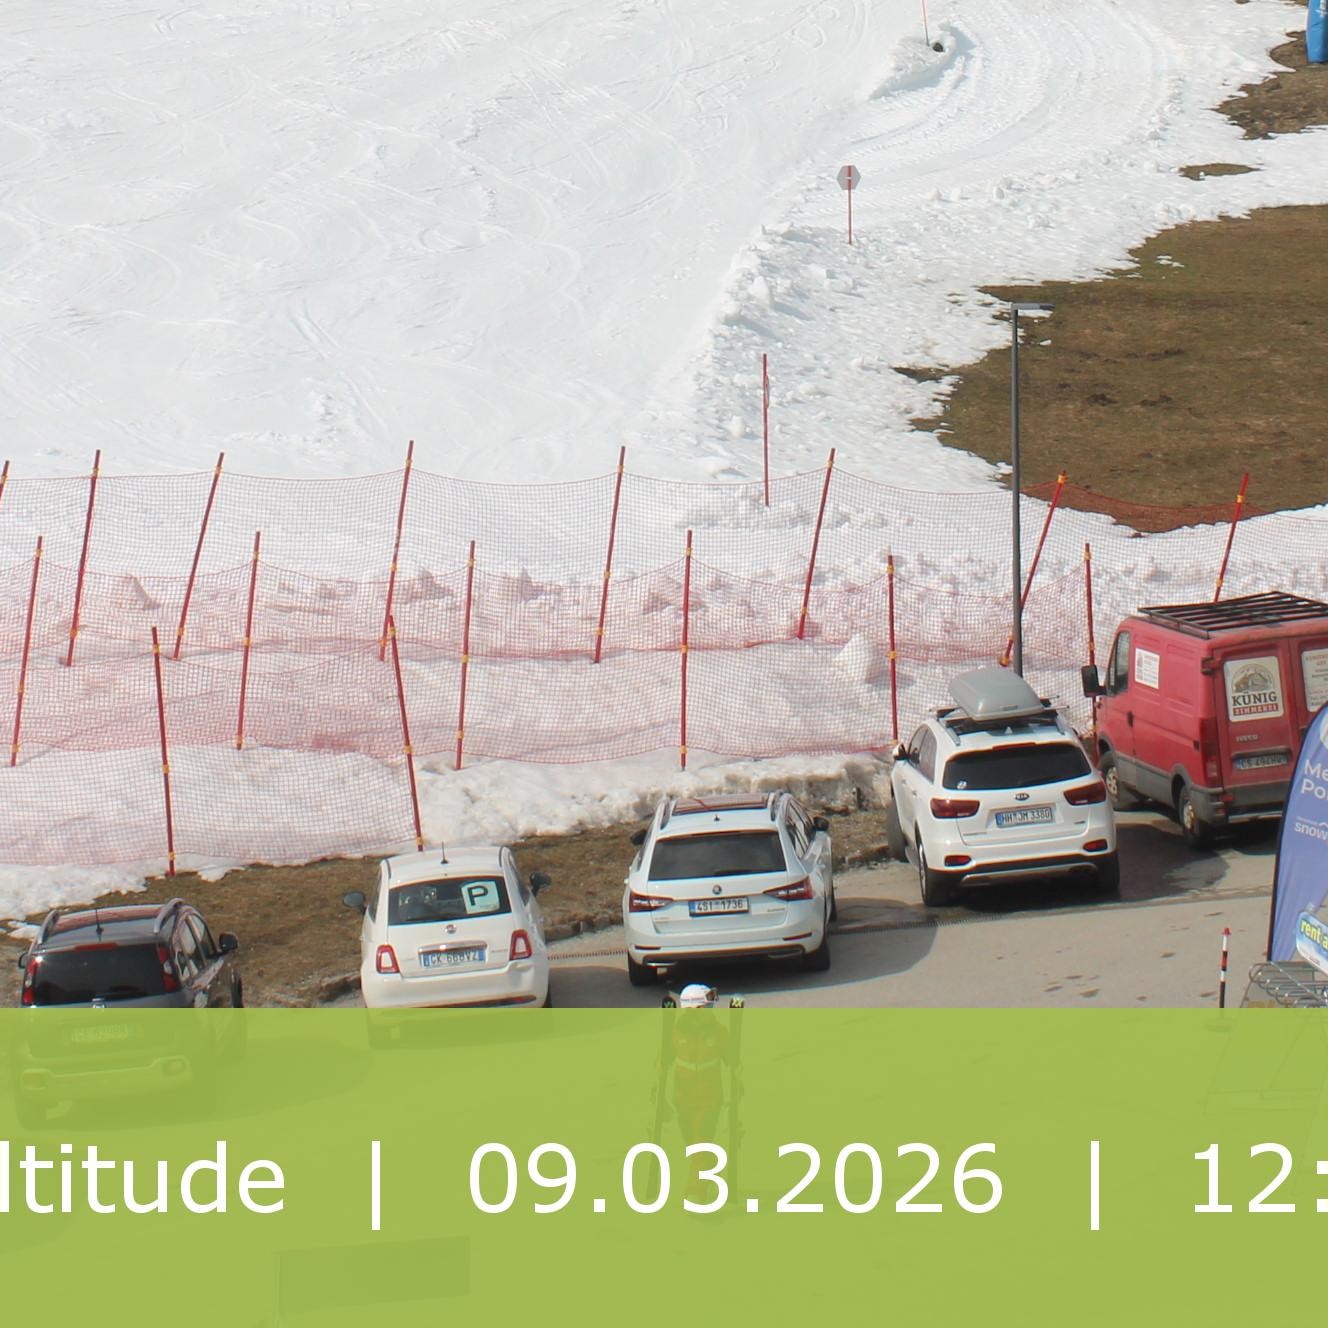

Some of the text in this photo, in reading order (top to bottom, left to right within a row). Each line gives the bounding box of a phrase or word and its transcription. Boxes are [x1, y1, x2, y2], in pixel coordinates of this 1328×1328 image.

[1232, 691, 1278, 707] KÜNIG
[1234, 704, 1278, 715] ZIMMEREI
[467, 885, 489, 907] P
[1300, 919, 1321, 944] rent
